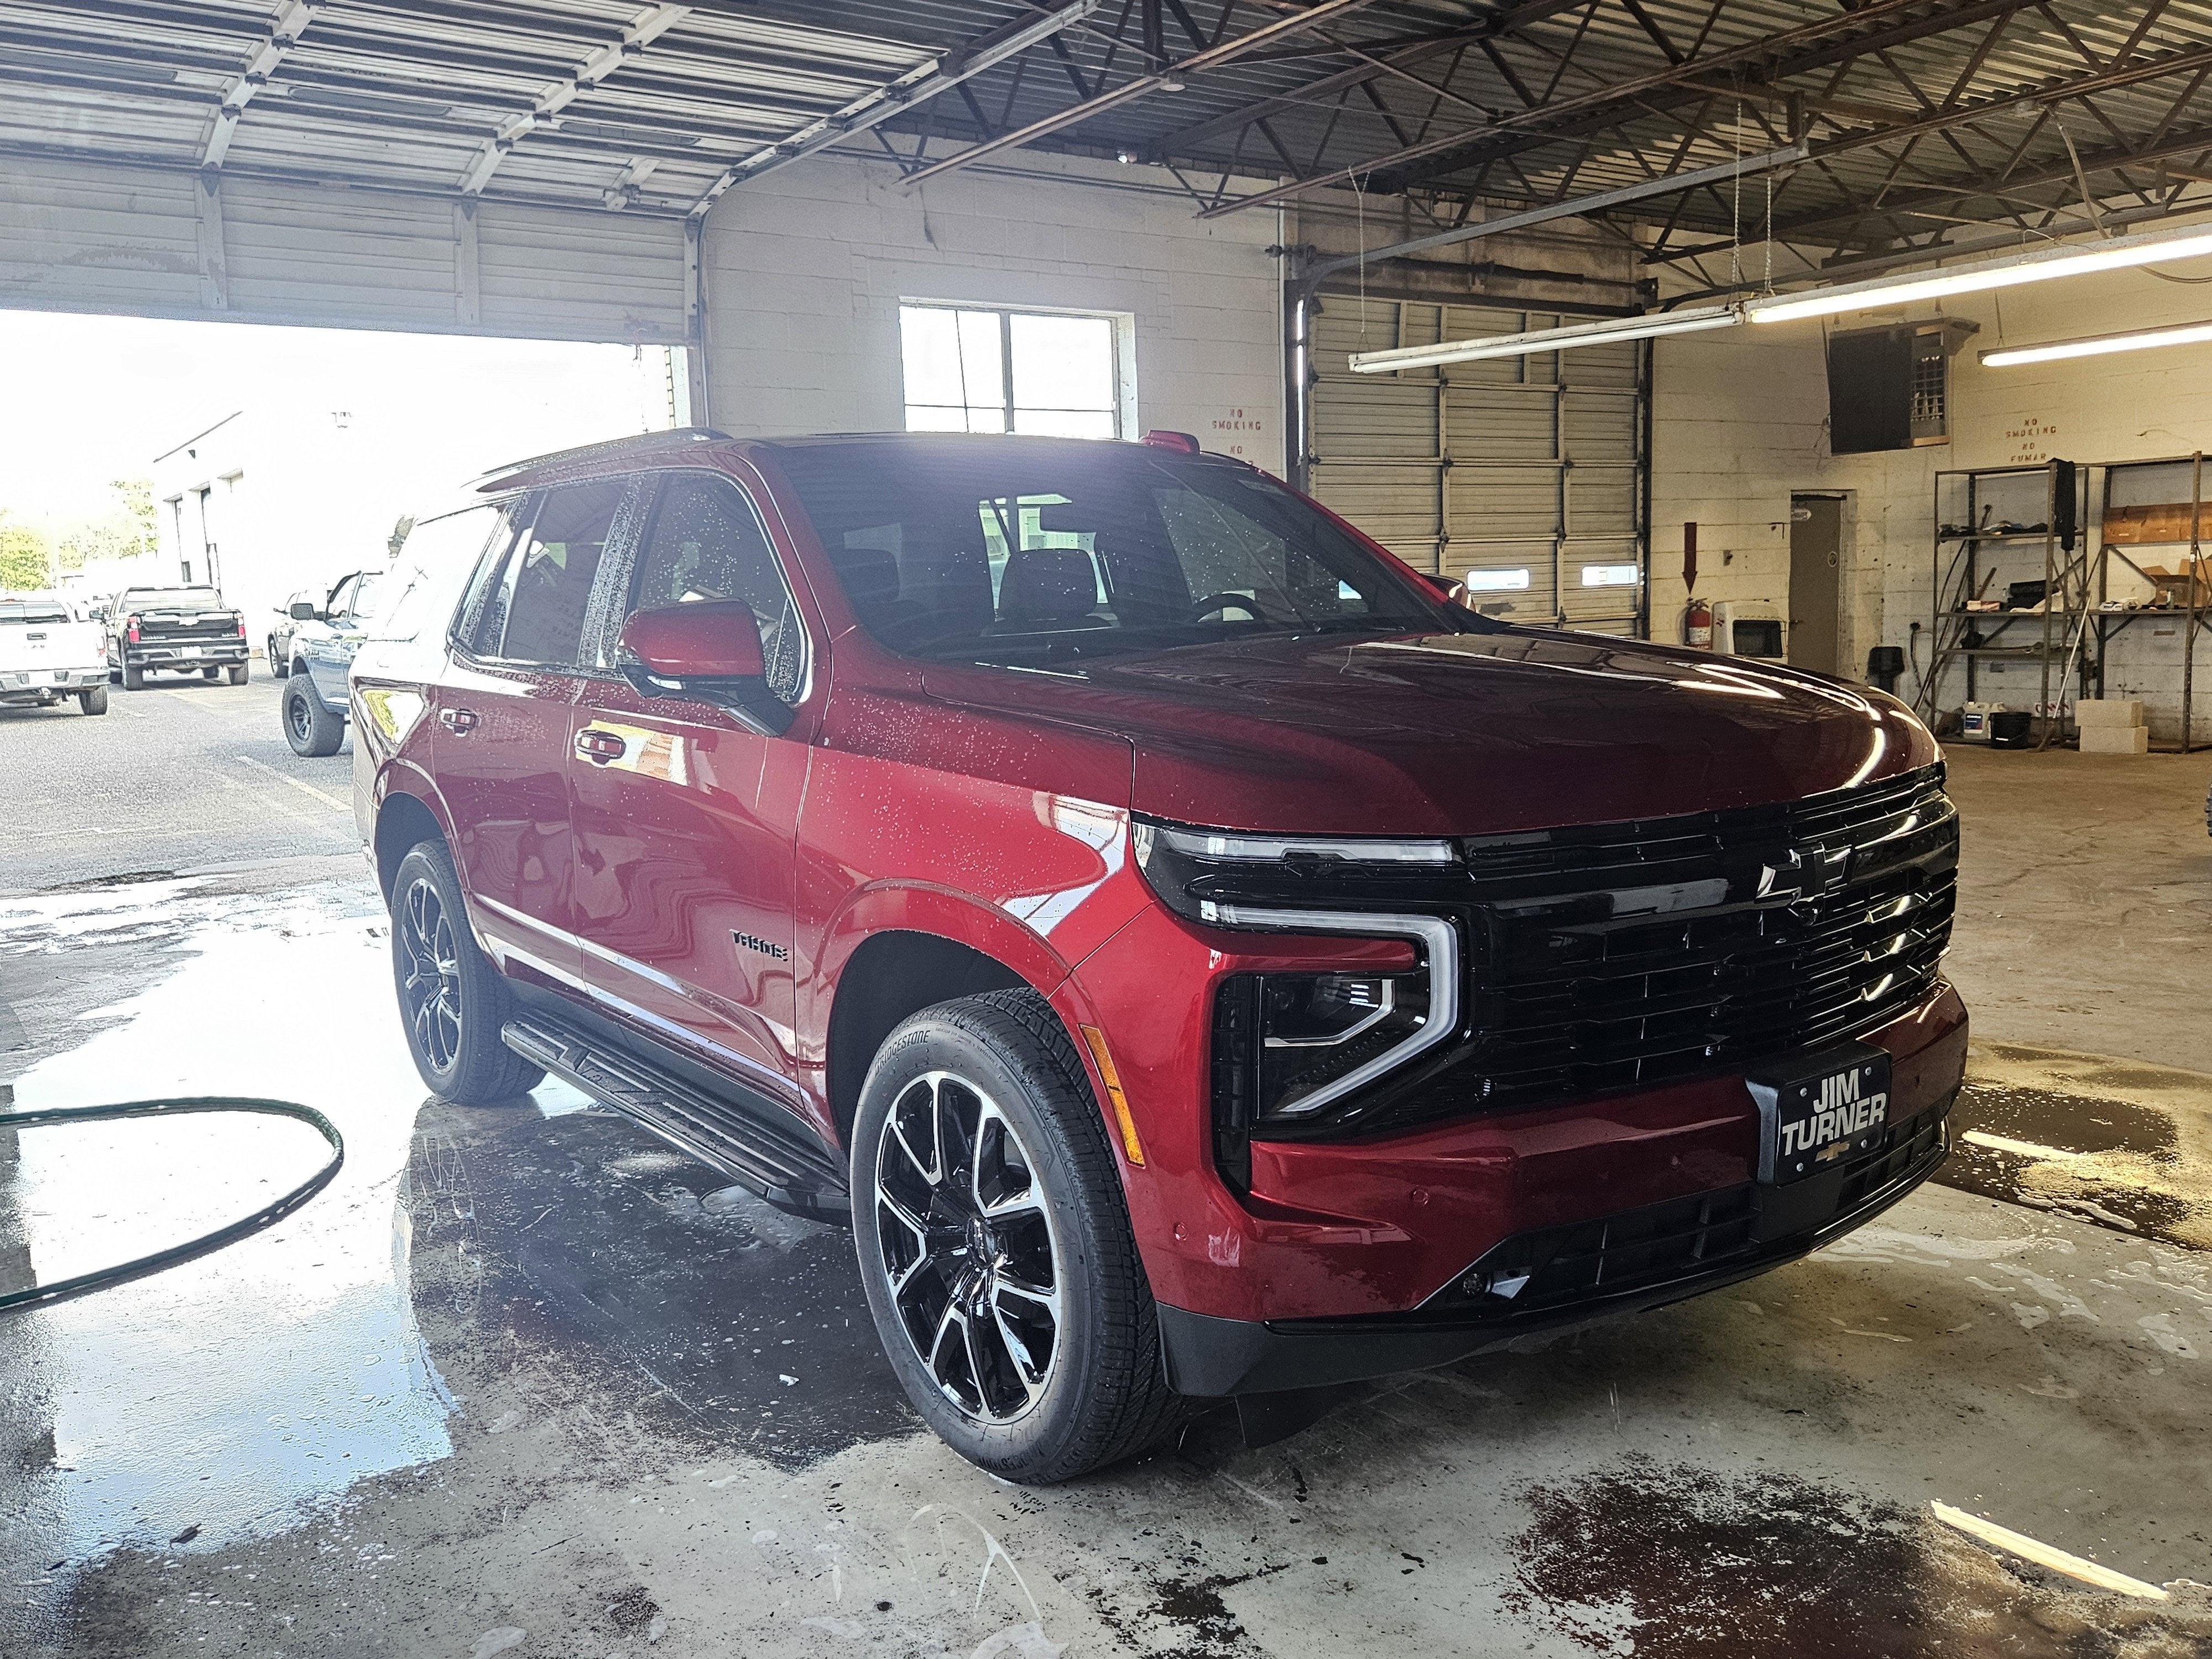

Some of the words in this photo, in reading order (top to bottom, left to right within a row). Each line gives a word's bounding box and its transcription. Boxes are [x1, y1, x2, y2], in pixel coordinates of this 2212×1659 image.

[1229, 409, 1243, 418] NO
[1211, 421, 1261, 431] SMOKING
[2005, 426, 2057, 438] SMOKING
[1229, 446, 1243, 454] NO
[2011, 453, 2047, 462] FUMAR
[729, 928, 788, 962] TAHOE
[1813, 1068, 1859, 1113] JIM
[1782, 1092, 1887, 1156] TURNER
